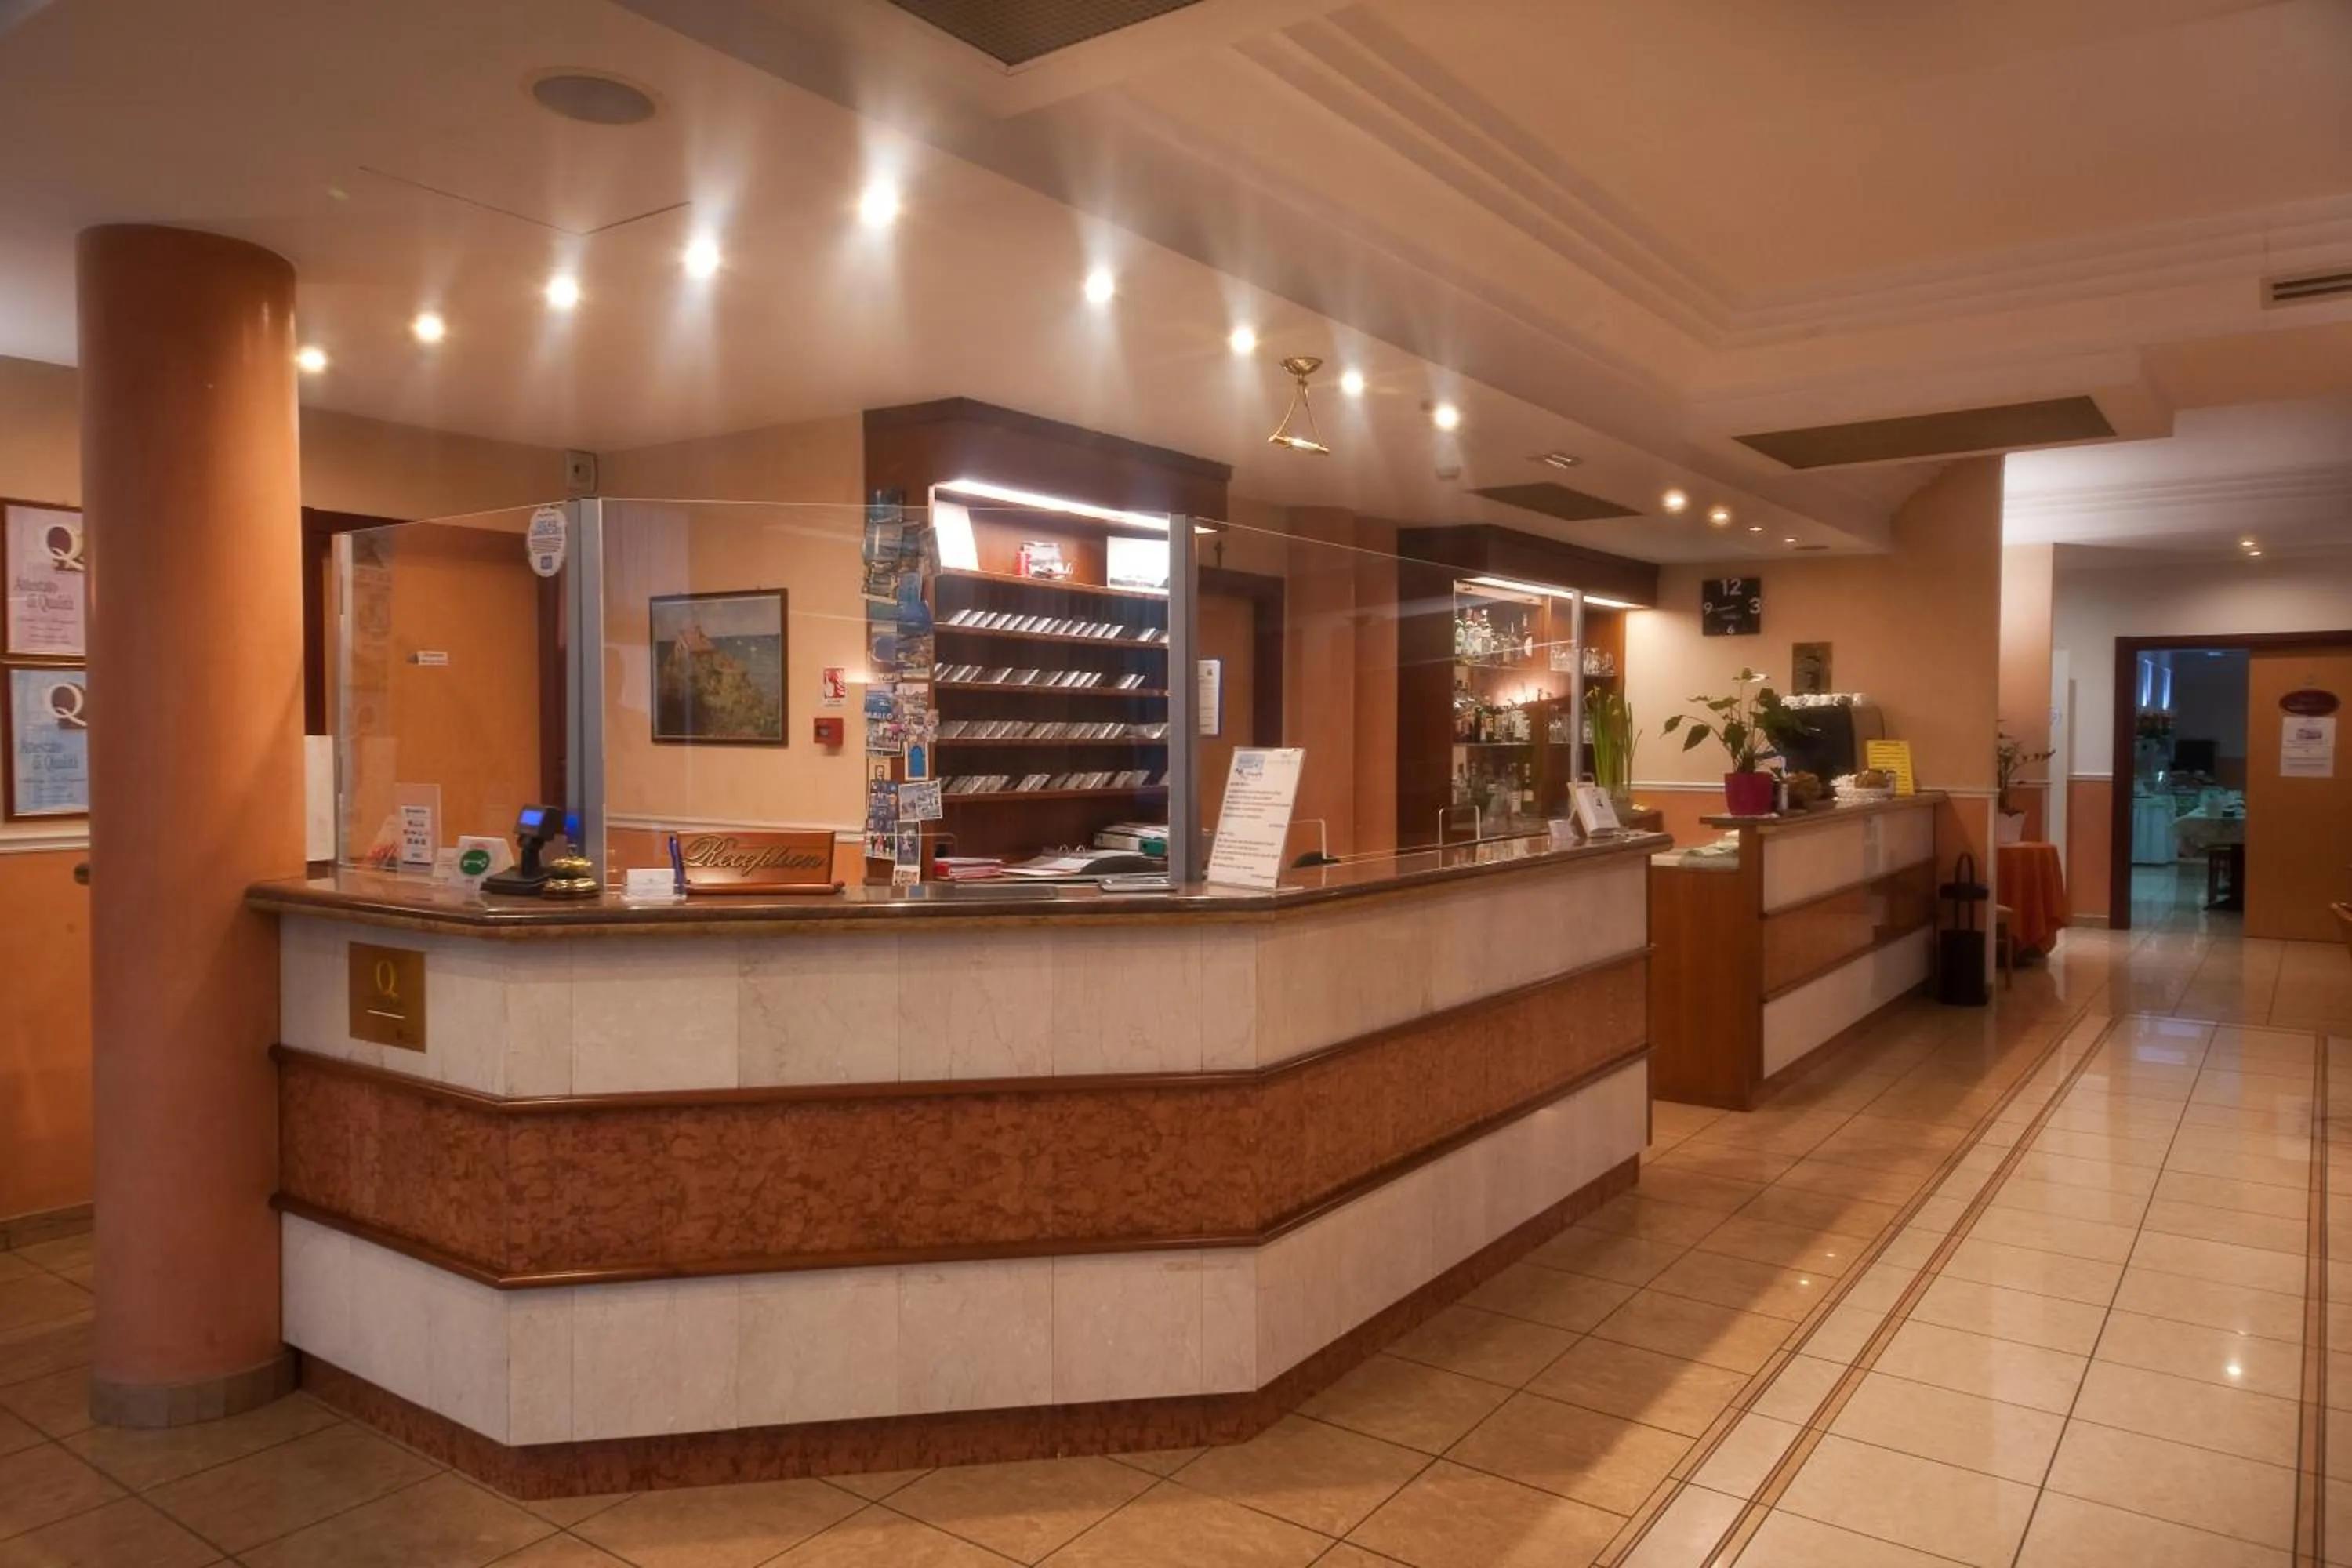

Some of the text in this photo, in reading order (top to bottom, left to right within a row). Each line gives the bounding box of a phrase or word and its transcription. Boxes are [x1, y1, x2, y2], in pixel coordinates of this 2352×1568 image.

[45, 524, 85, 570] Q
[1704, 597, 1761, 615] 9 3
[1721, 577, 1742, 596] 12
[1726, 625, 1736, 635] 6
[47, 682, 87, 726] Q
[684, 833, 827, 877] Reception
[376, 960, 400, 1003] Q
